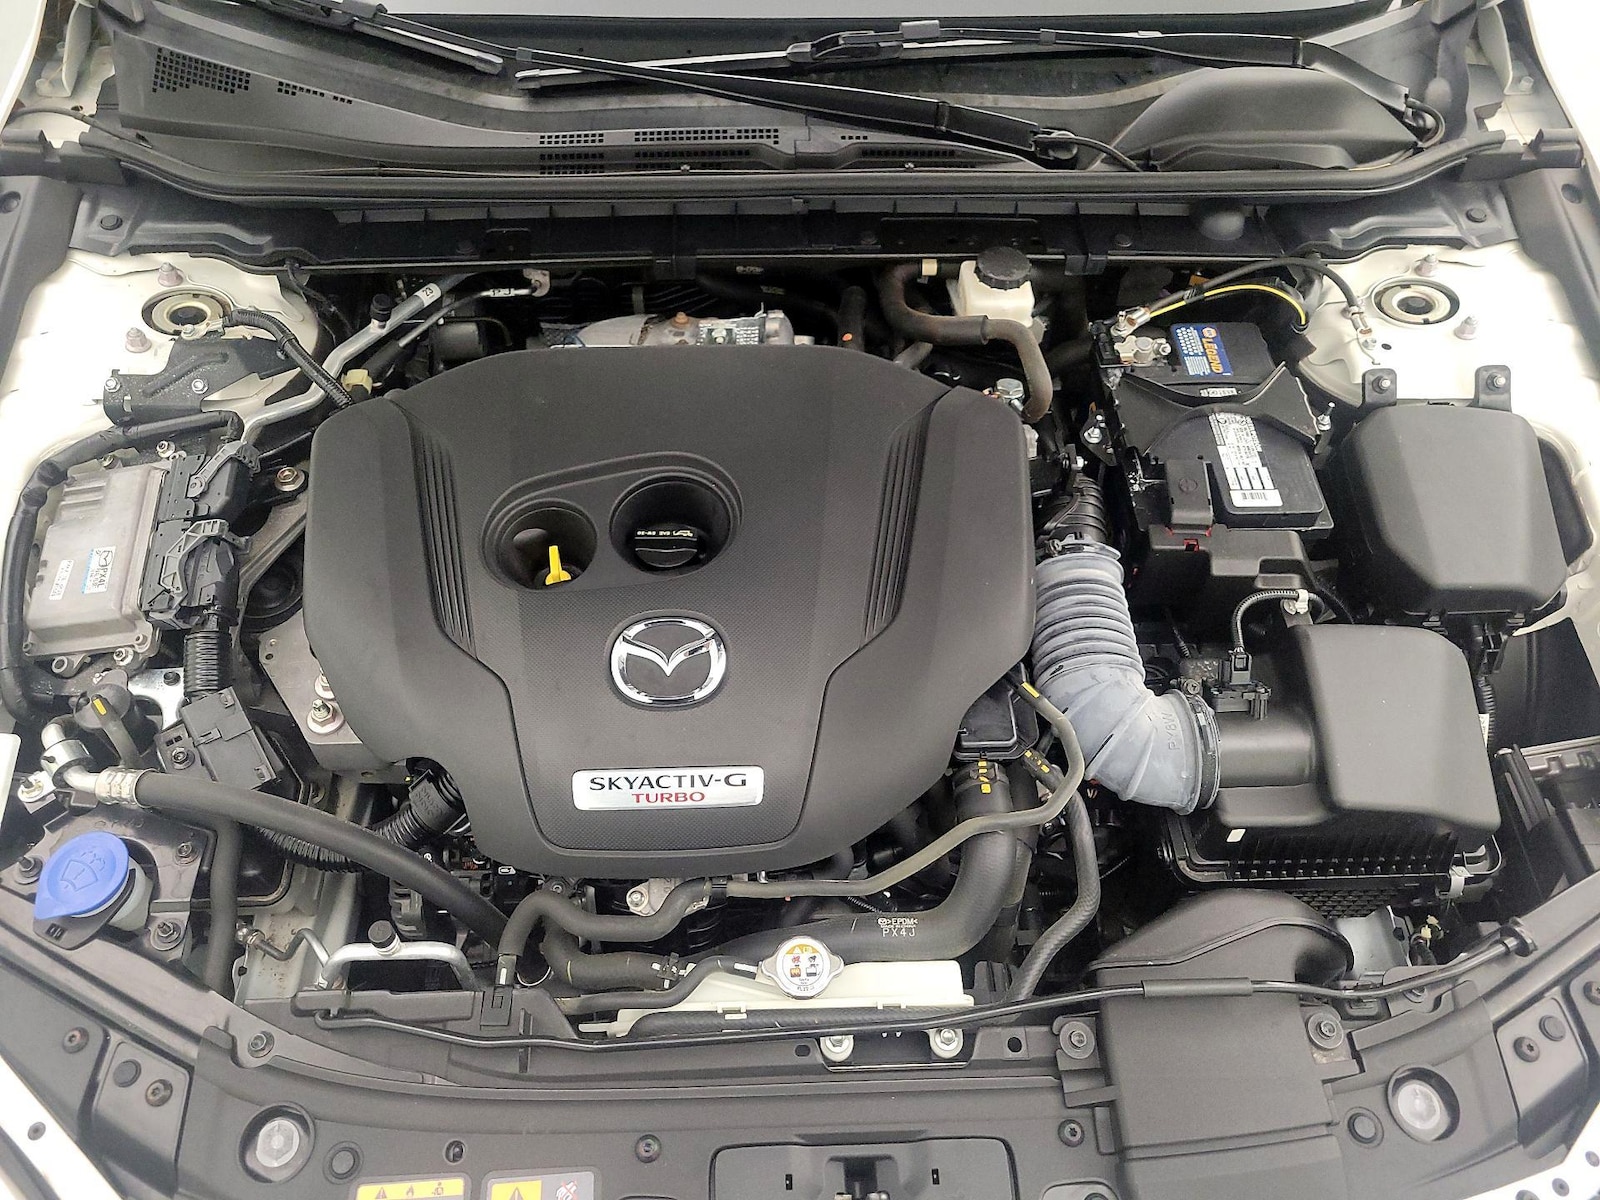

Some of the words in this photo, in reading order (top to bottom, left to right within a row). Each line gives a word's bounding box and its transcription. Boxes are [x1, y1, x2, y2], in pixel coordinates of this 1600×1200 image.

[422, 287, 434, 297] 23
[1201, 337, 1224, 374] LEGEND
[589, 773, 747, 791] SKYACTIV-G
[631, 791, 706, 804] TURBO
[882, 927, 916, 938] PX4J
